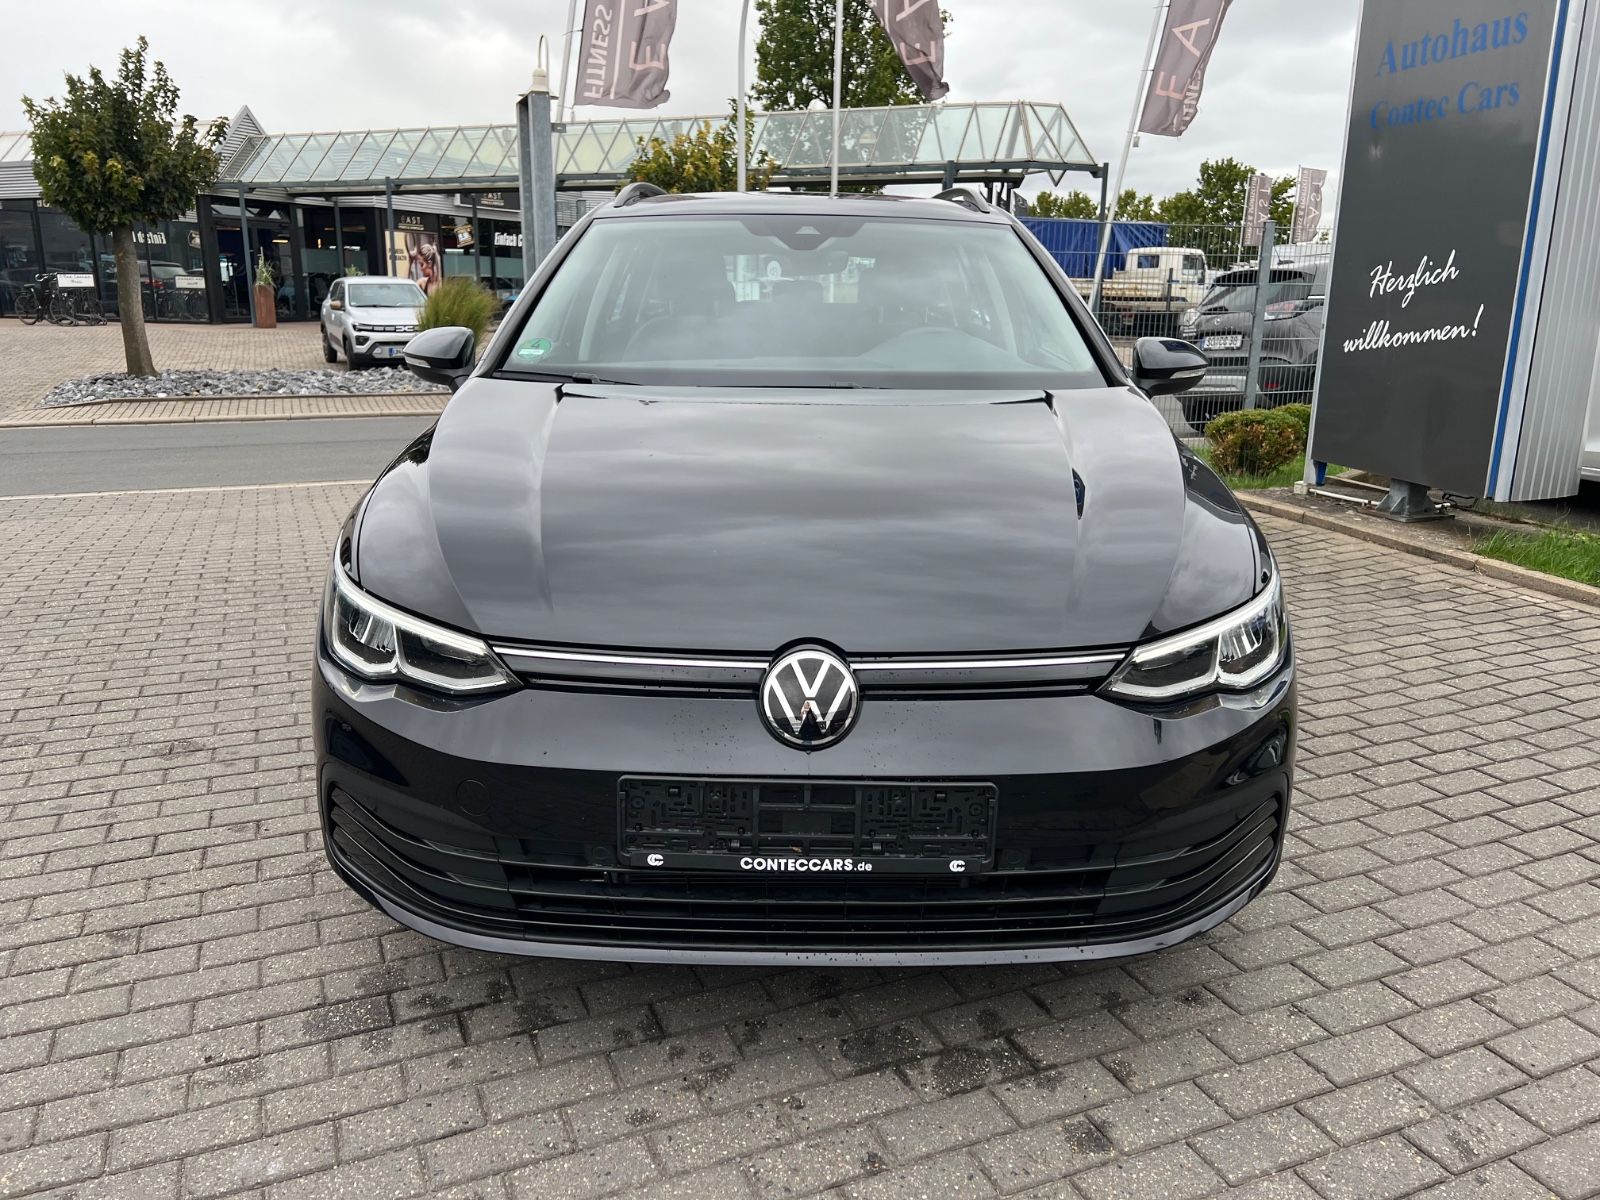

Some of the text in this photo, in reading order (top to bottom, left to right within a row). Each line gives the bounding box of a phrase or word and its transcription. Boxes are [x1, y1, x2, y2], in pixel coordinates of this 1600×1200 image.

[1375, 11, 1529, 77] Autohaus
[1370, 81, 1520, 129] Contec Cars
[1369, 249, 1459, 308] Herzlich
[1343, 303, 1484, 352] willkommen!
[740, 857, 872, 871] CONTECCARS.de
